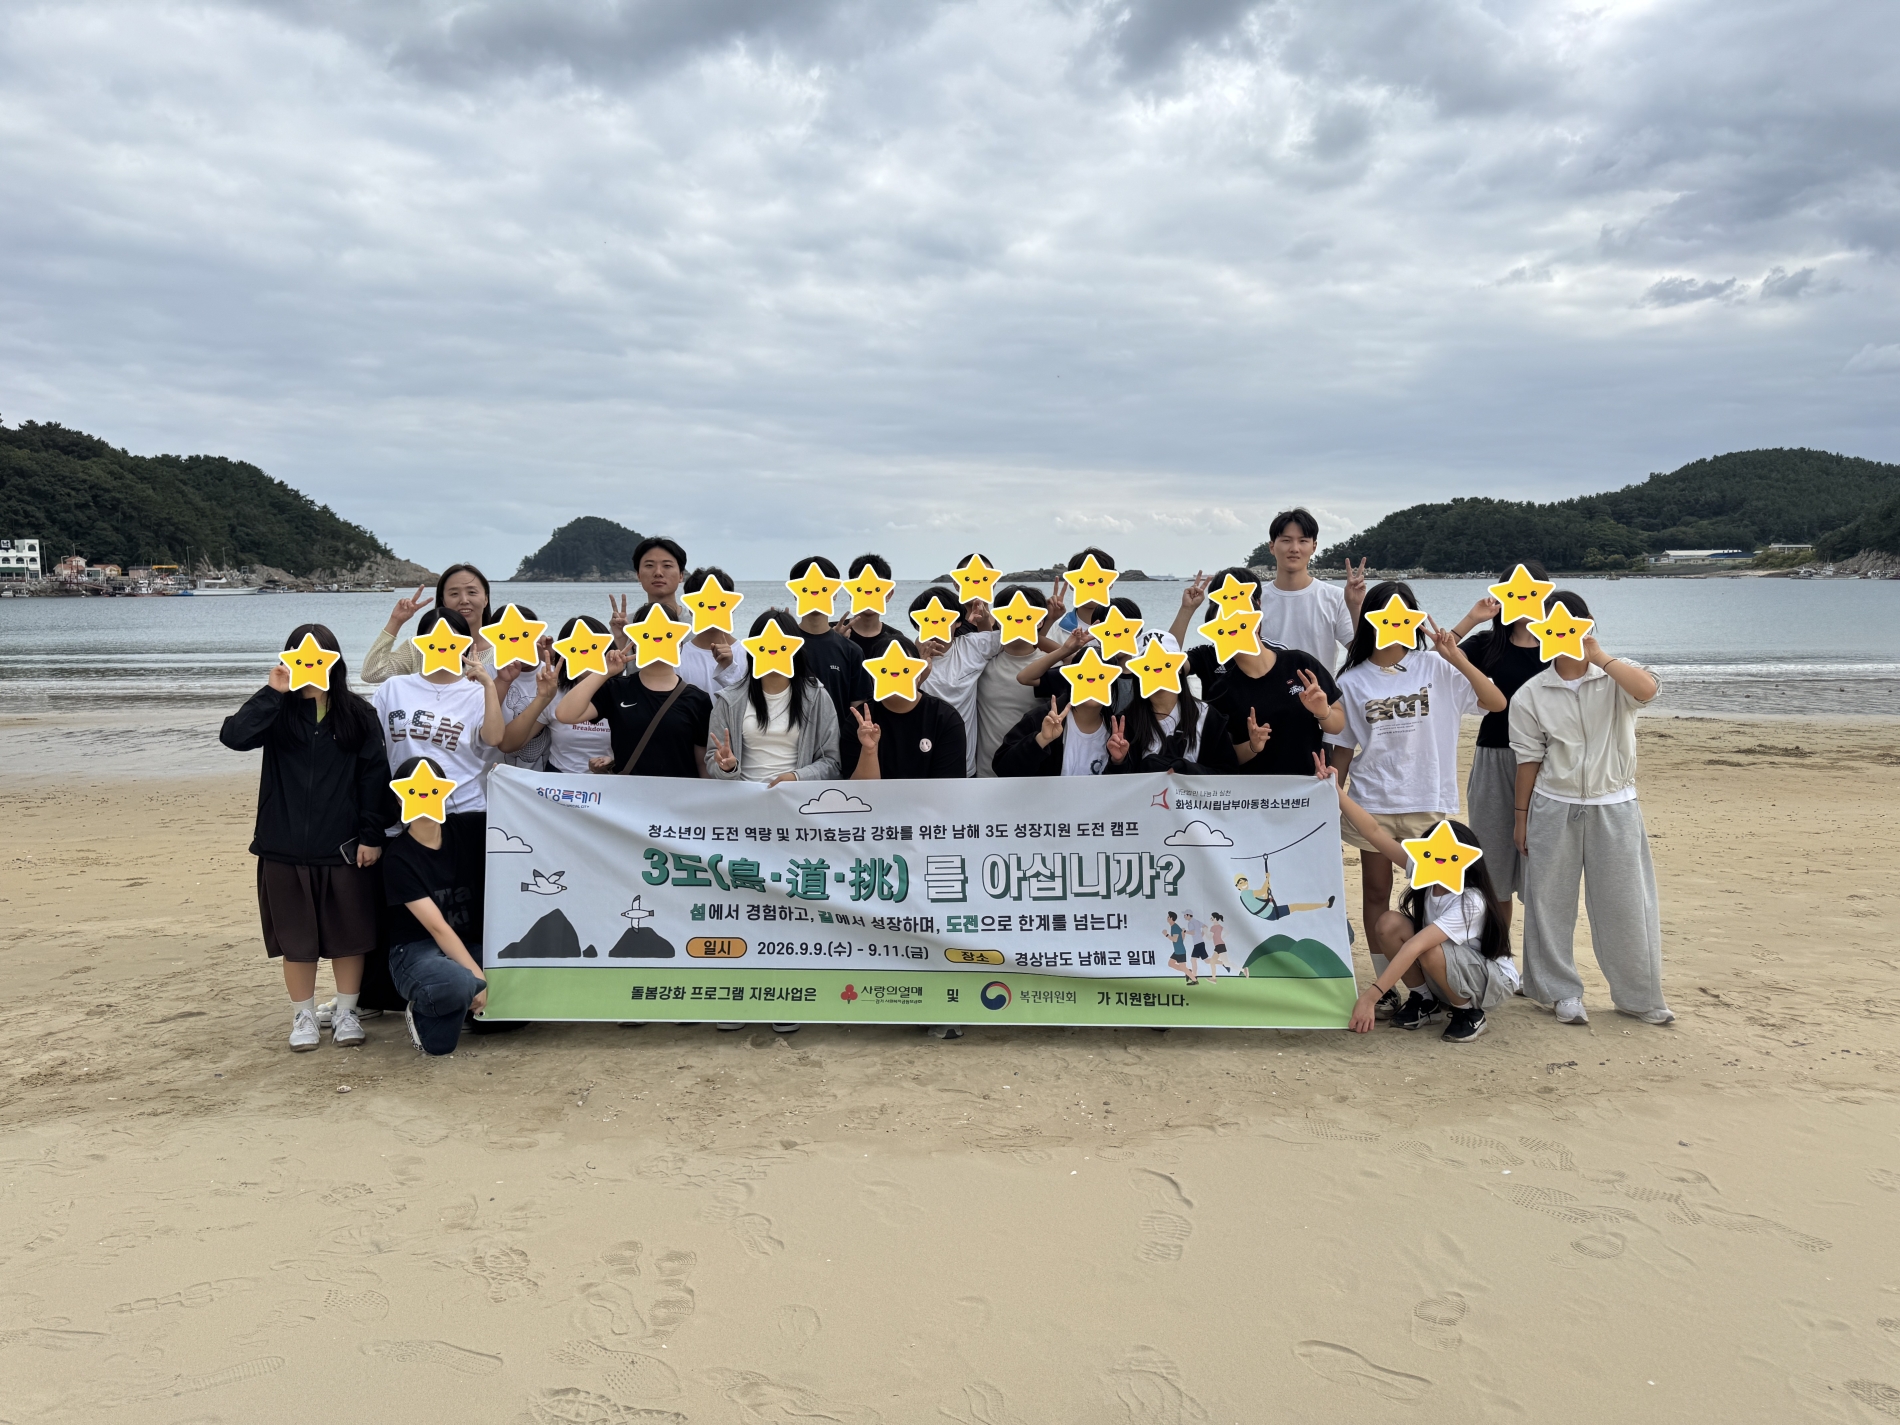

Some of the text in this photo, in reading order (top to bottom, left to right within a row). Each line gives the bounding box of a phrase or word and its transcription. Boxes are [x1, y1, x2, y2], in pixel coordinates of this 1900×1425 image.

[388, 709, 465, 752] CSM
[536, 787, 602, 805] 화성특례시
[1175, 797, 1310, 811] 화성시시립남부아동청소년센터
[649, 821, 1140, 843] 청소년의 도전 역량 및 자기효능감 강화를 위한 남해 3도 성장지원 도전 캠프
[924, 854, 968, 902] 를
[982, 852, 1185, 901] 아십니까?
[690, 903, 1128, 934] 섬에서 경험하고, 길에서 성장하며, 도전으로 한계를 넘는다!
[703, 940, 731, 956] 일시
[757, 940, 853, 958] 2026.9.9.(수)
[868, 943, 929, 960] 9.11.(금)
[960, 950, 989, 963] 장소
[1015, 950, 1156, 968] 경상남도 남해군 일대
[631, 985, 817, 1002] 돌봄강화 프로그램 지원사업은
[861, 986, 923, 998] 사랑의열매
[947, 988, 959, 1003] 및
[1019, 990, 1077, 1006] 복권위원회
[1097, 991, 1190, 1008] 가 지원합니다.
